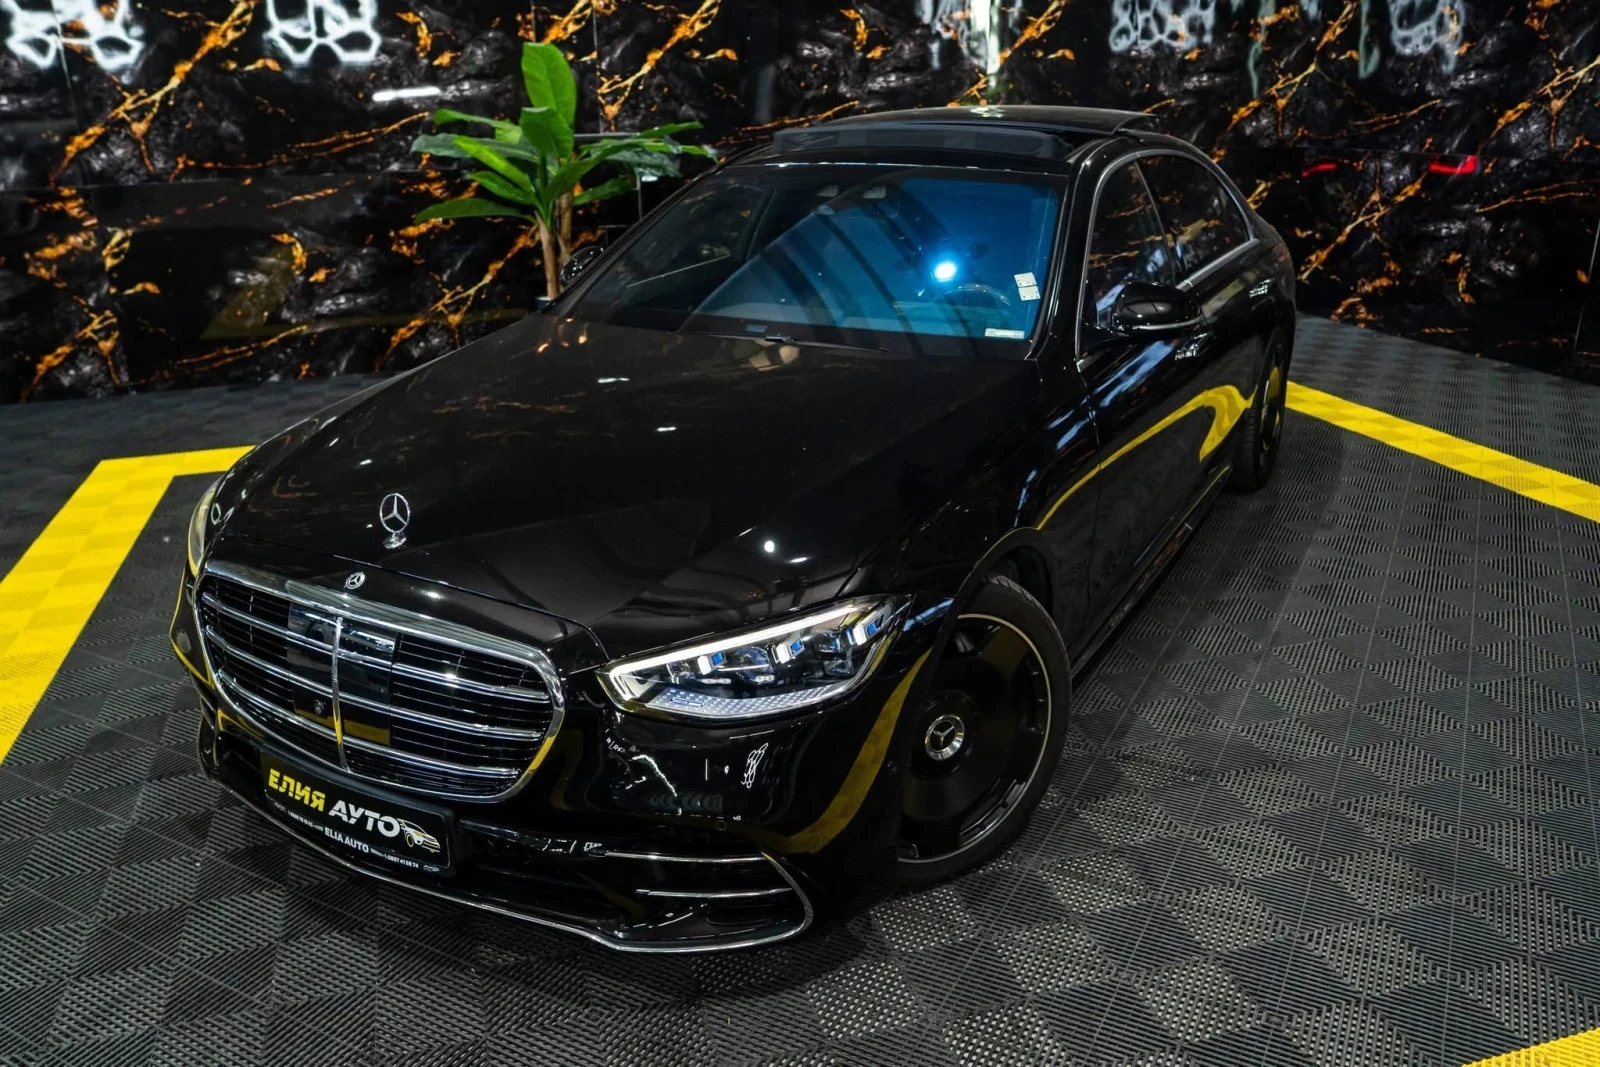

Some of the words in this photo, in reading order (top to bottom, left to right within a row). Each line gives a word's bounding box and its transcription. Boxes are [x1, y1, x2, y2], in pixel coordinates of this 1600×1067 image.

[268, 768, 326, 812] ЕЛИЯ
[328, 800, 400, 838] АУТО
[324, 826, 344, 843] ELIA
[344, 836, 370, 853] AUTO
